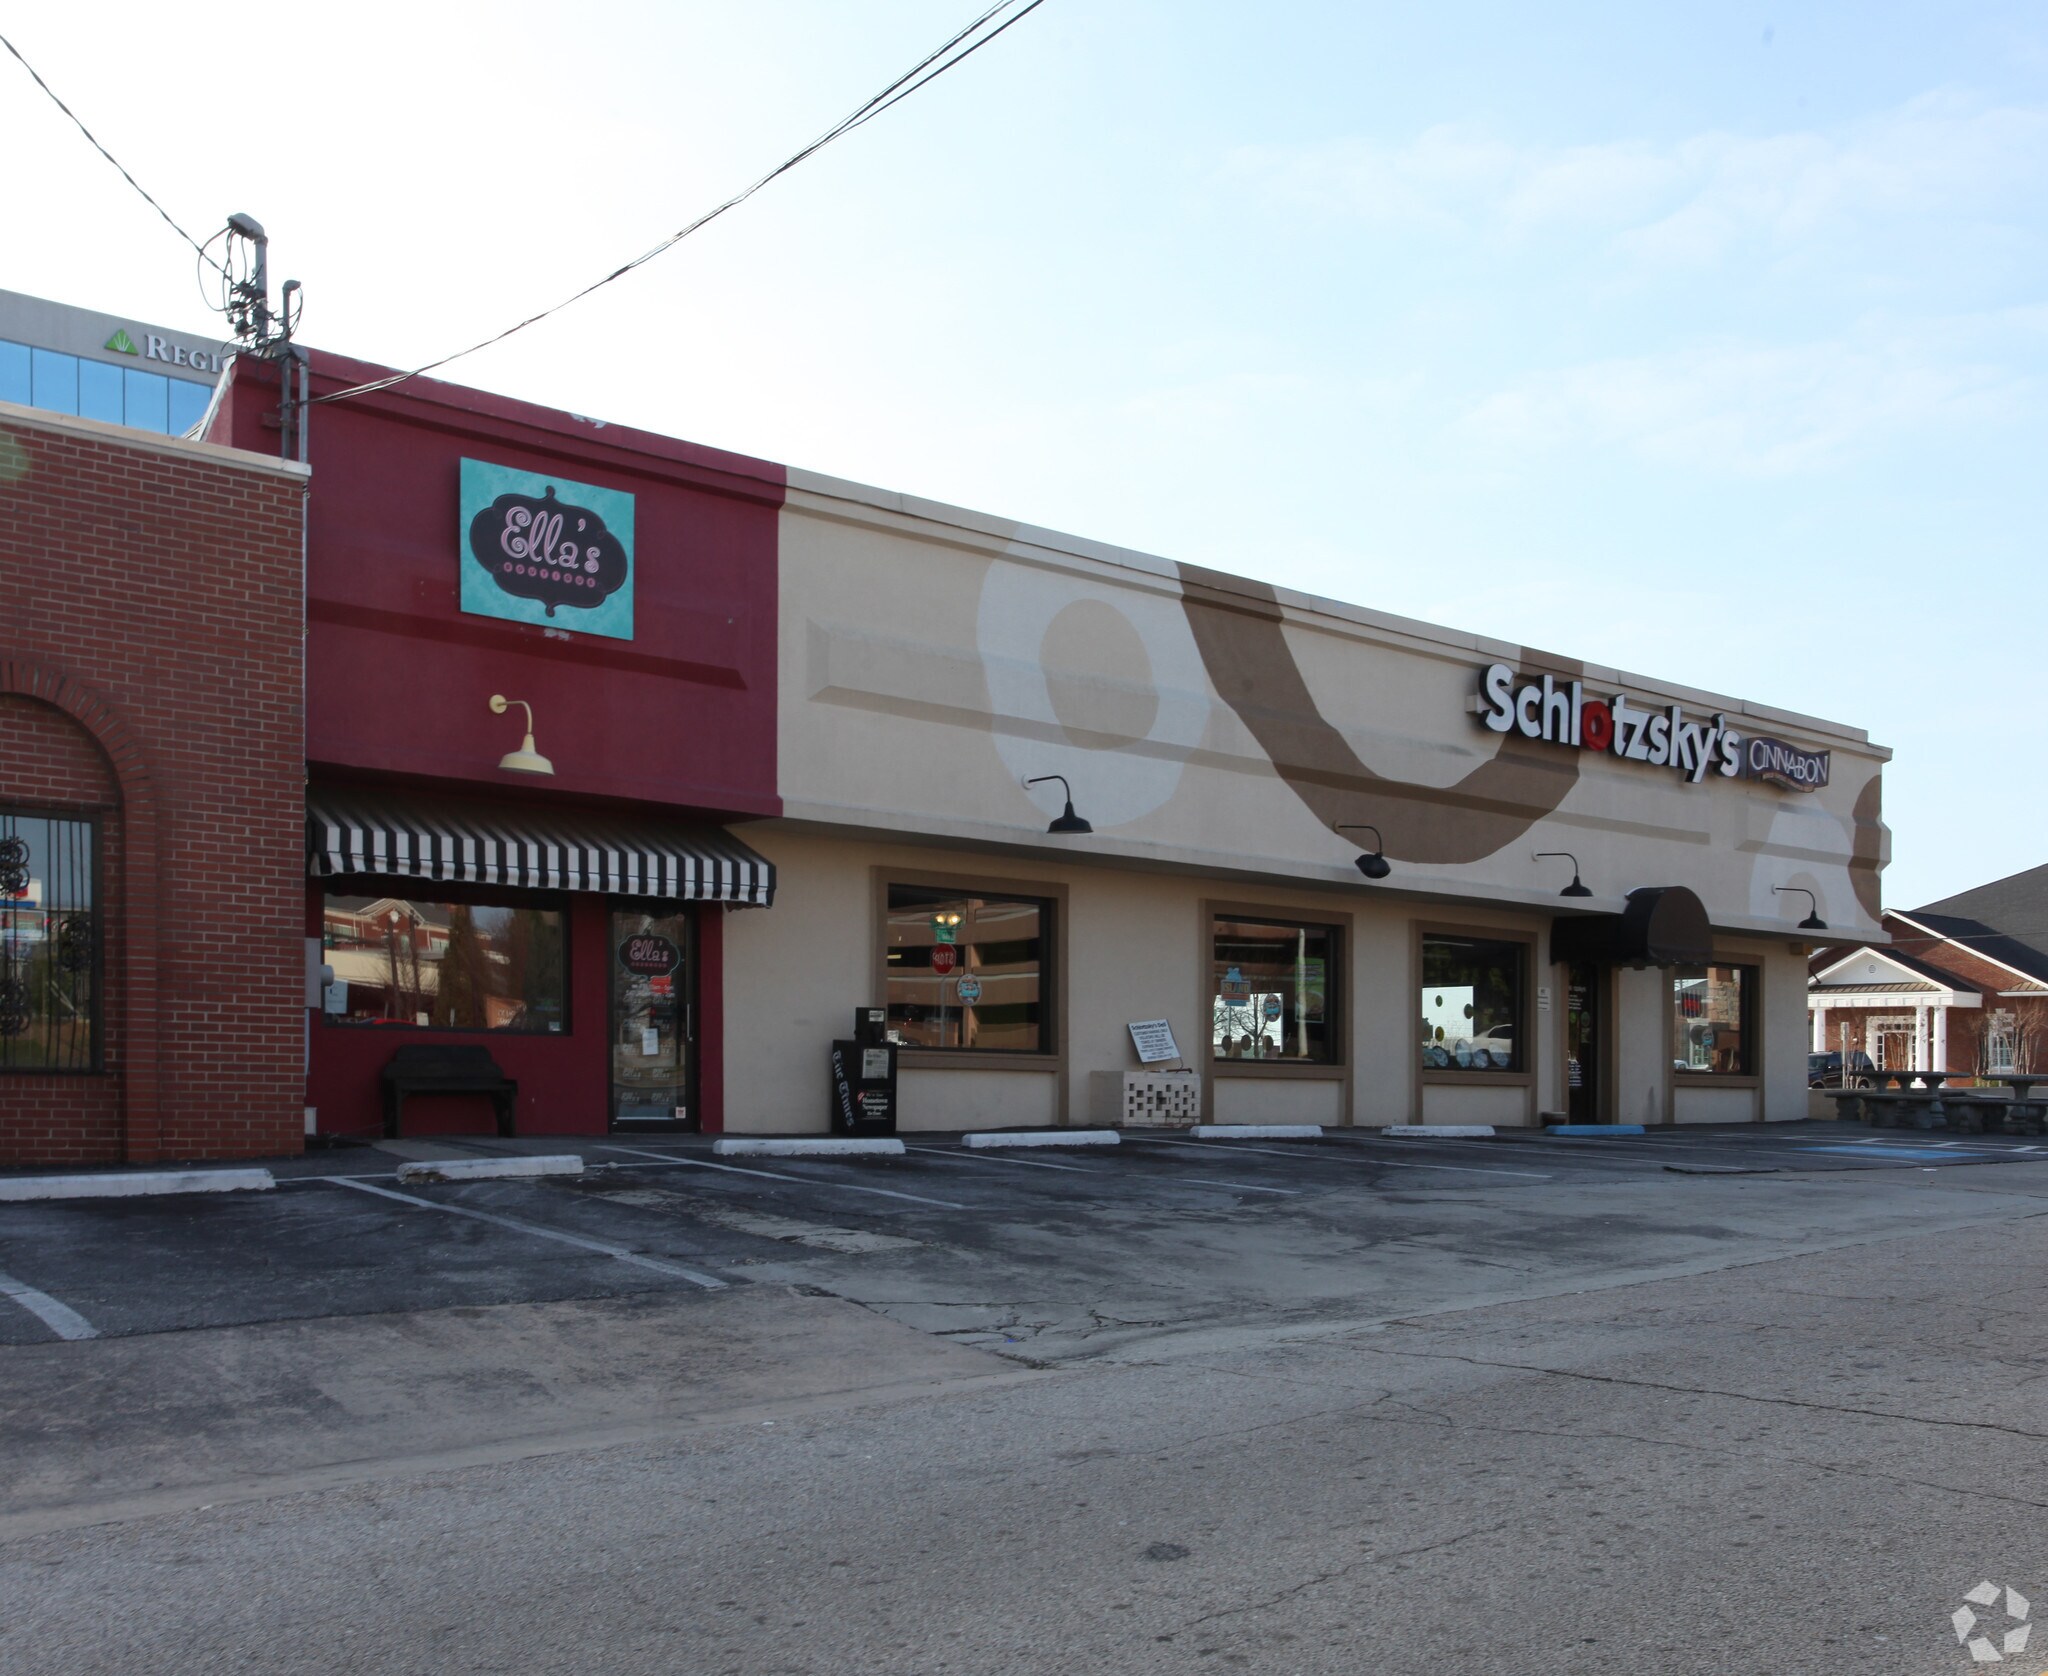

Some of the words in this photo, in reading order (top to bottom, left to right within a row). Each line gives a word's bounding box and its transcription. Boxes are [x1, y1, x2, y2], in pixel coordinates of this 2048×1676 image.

[145, 334, 231, 374] REGI
[501, 506, 601, 574] Ella's
[1480, 663, 1741, 783] Schlotzsky's
[1750, 739, 1828, 783] CINNABON
[629, 938, 669, 962] Ella's
